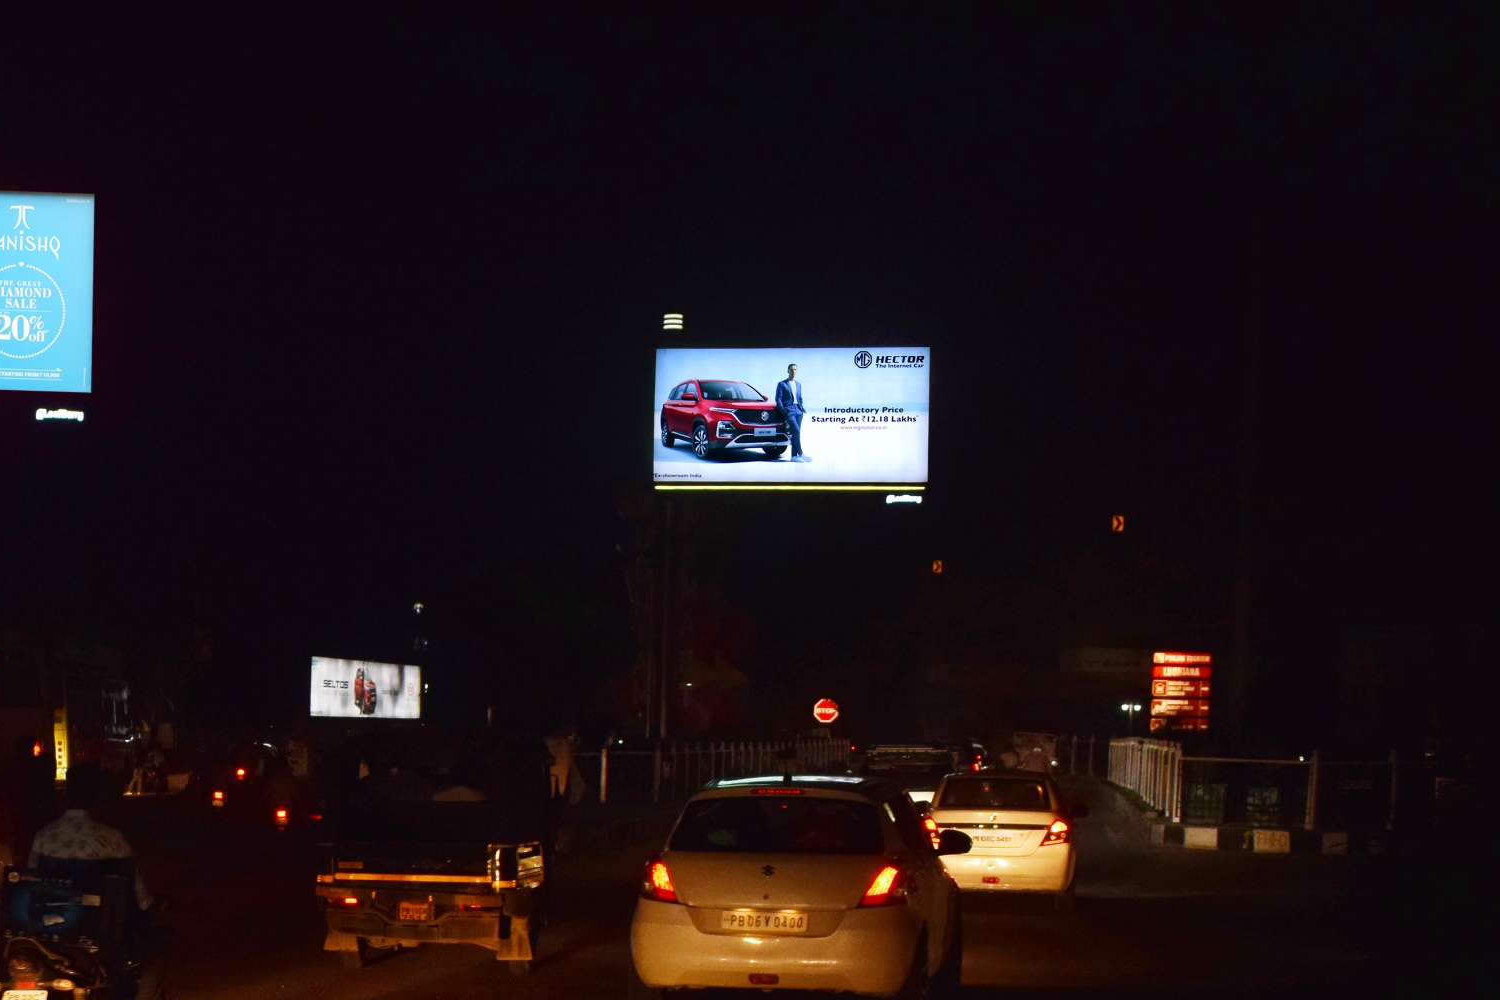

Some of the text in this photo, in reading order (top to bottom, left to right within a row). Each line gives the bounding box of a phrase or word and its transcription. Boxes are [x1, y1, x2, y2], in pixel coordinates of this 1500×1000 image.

[5, 298, 37, 309] SALE
[811, 416, 846, 424] Starting
[323, 680, 348, 689] SELTOS
